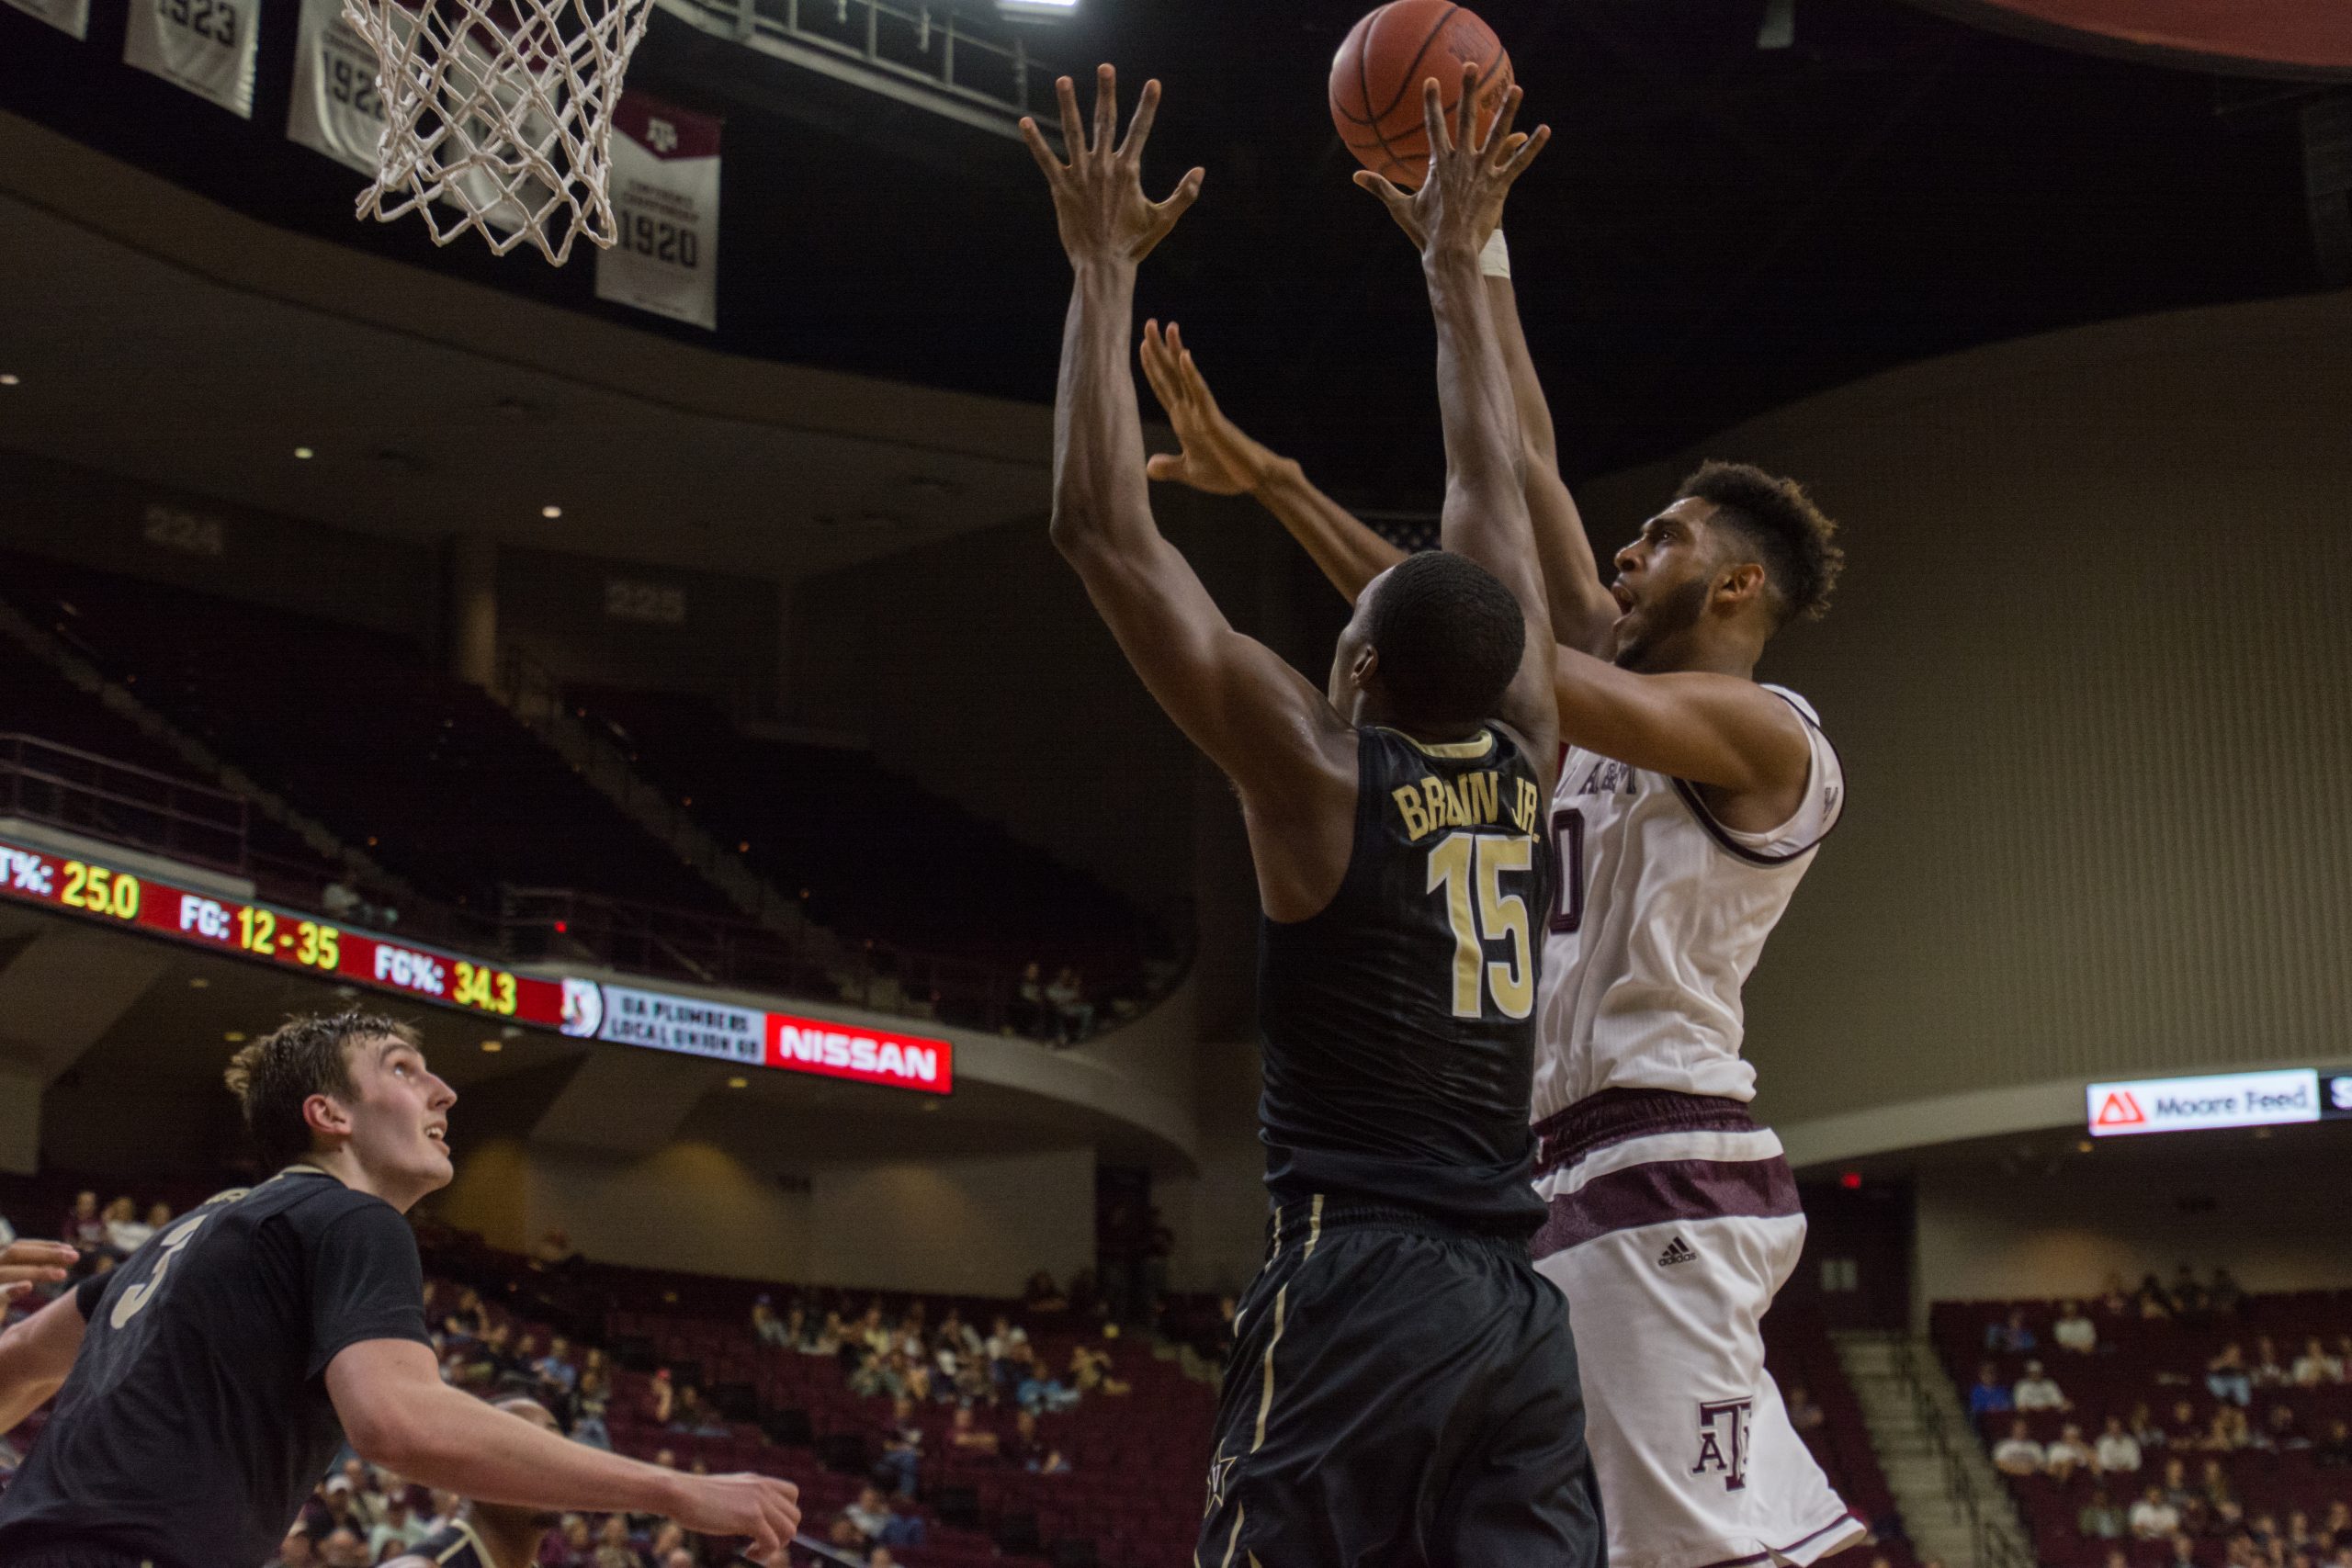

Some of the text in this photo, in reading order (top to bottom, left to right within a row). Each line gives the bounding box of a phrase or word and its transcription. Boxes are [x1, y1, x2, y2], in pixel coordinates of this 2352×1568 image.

[622, 209, 697, 268] 1920
[1510, 776, 1541, 844] JR.
[61, 860, 141, 919] 25.0
[180, 894, 231, 941] FG:
[237, 906, 276, 955] 12
[297, 920, 340, 970] 35
[374, 944, 446, 995] FG%:
[453, 960, 517, 1016] 34.3
[1426, 831, 1534, 1020] 15
[610, 1017, 667, 1044] LOCAL
[673, 1029, 730, 1052] UNION
[653, 1000, 750, 1032] PLUMBERS
[779, 1024, 937, 1083] NISSAN
[2155, 1083, 2309, 1120] Moore Feed
[109, 1213, 209, 1330] 3
[1657, 1252, 1698, 1268] adidas
